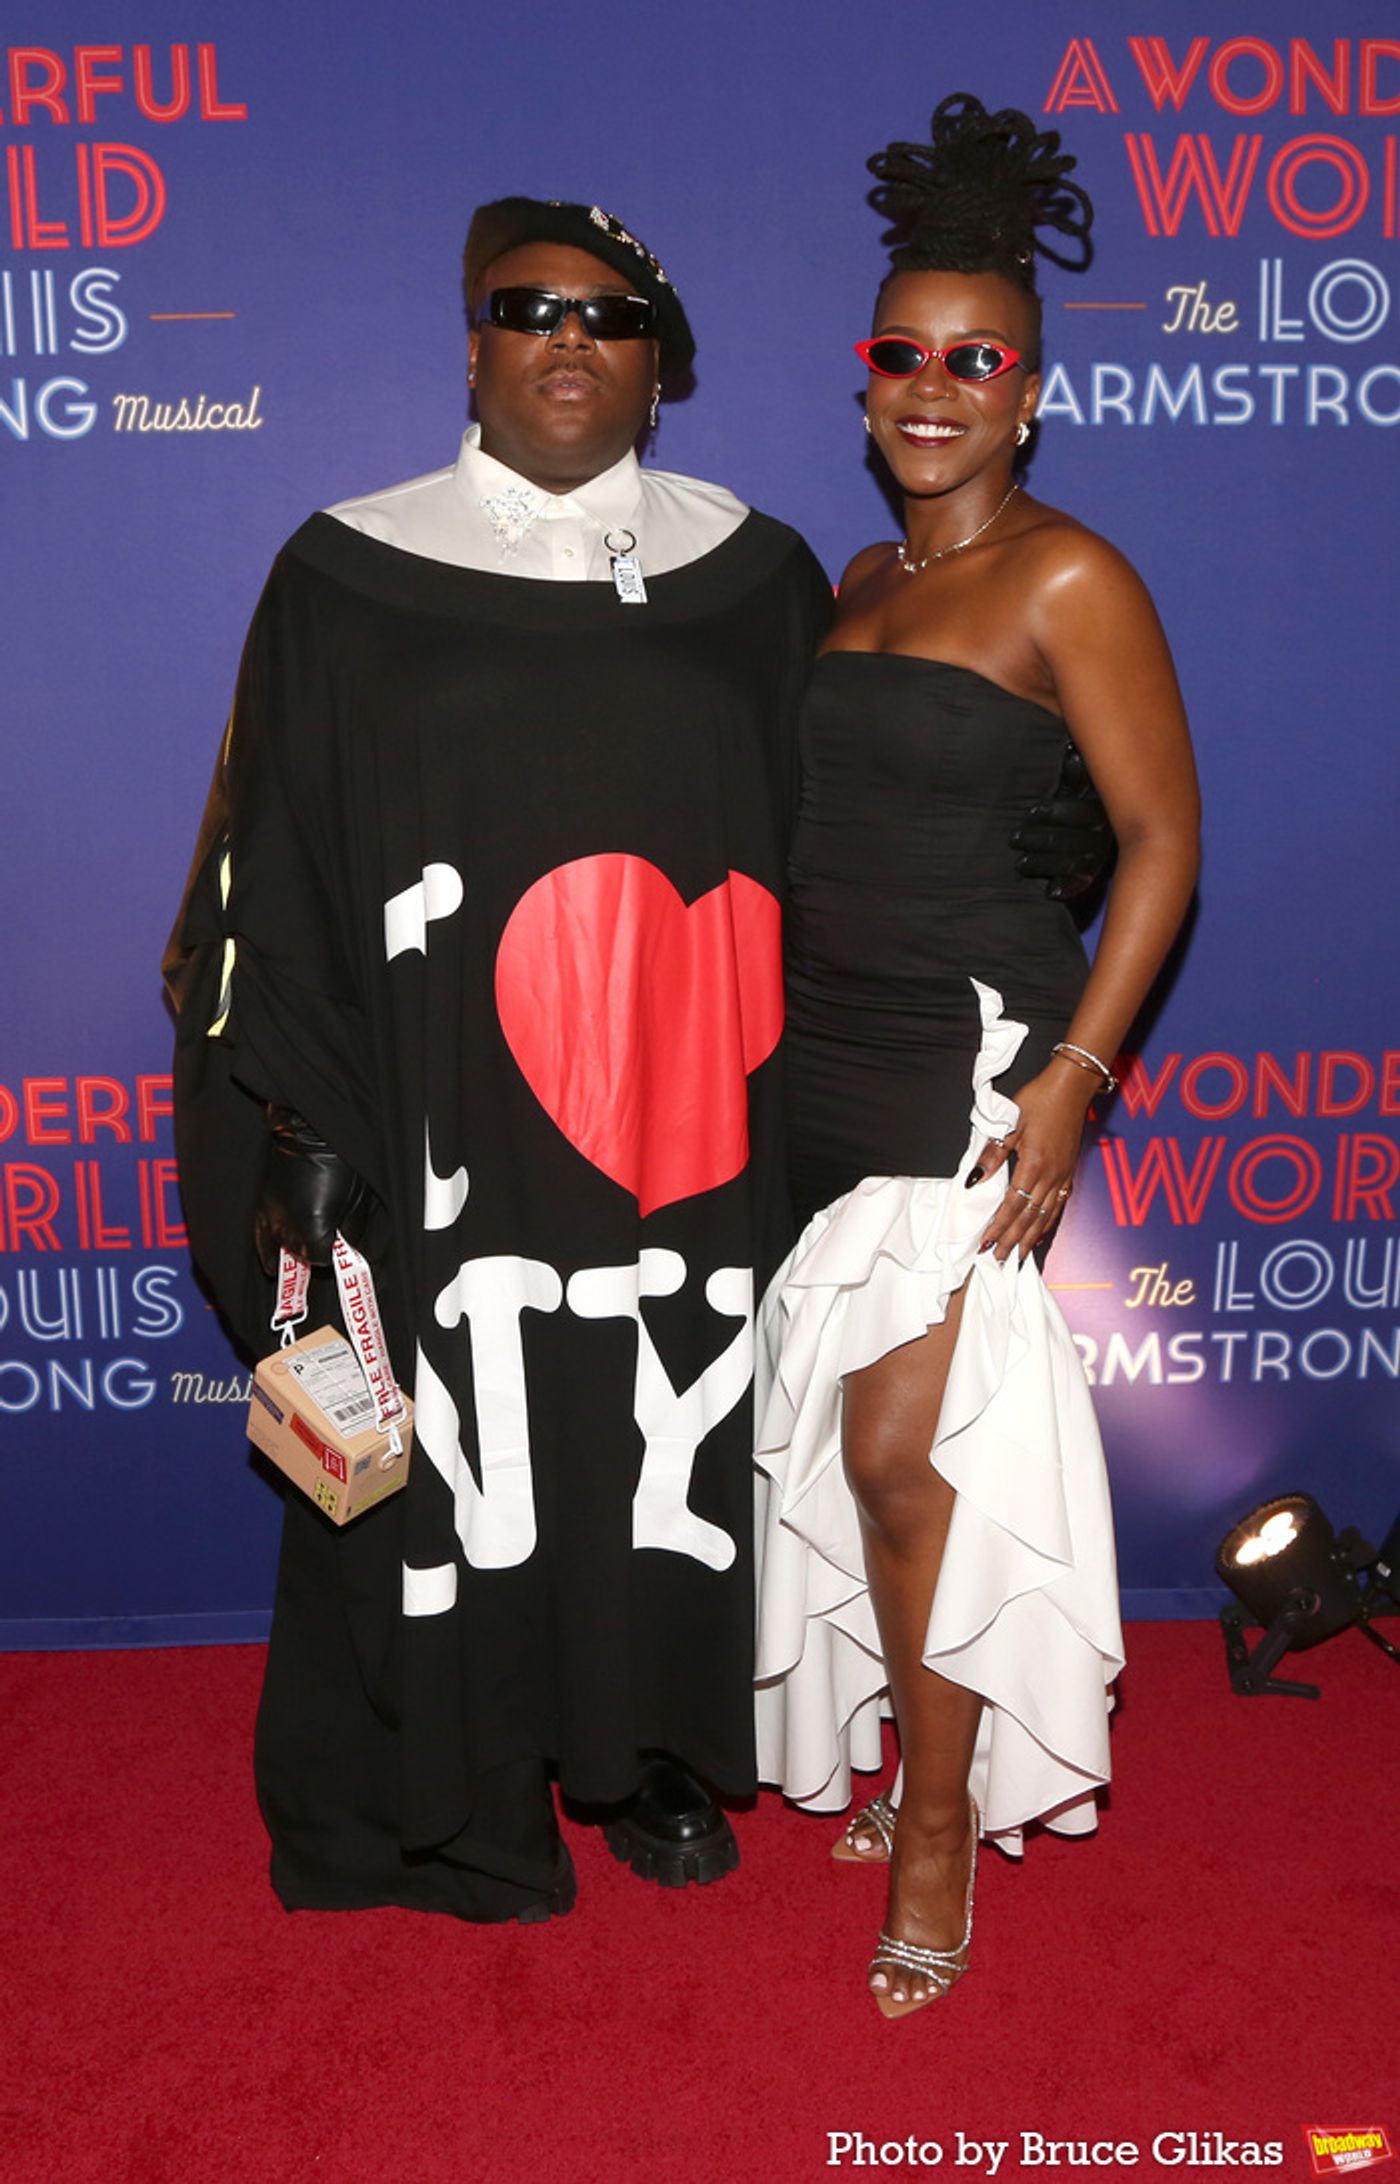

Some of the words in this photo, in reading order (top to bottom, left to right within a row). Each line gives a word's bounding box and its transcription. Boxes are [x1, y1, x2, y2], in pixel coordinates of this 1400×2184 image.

[0, 43, 248, 125] RFUL
[1042, 37, 1120, 113] A
[1124, 133, 1400, 239] WO
[1162, 281, 1240, 334] The
[1260, 258, 1391, 343] LO
[112, 385, 263, 433] Musical
[1036, 362, 1400, 426] ARMSTRO
[1099, 1133, 1400, 1227] WOR
[0, 1265, 182, 1342] UIS
[344, 1274, 378, 1364] FRAGILE
[1125, 1262, 1196, 1309] The
[0, 1357, 156, 1413] ONG
